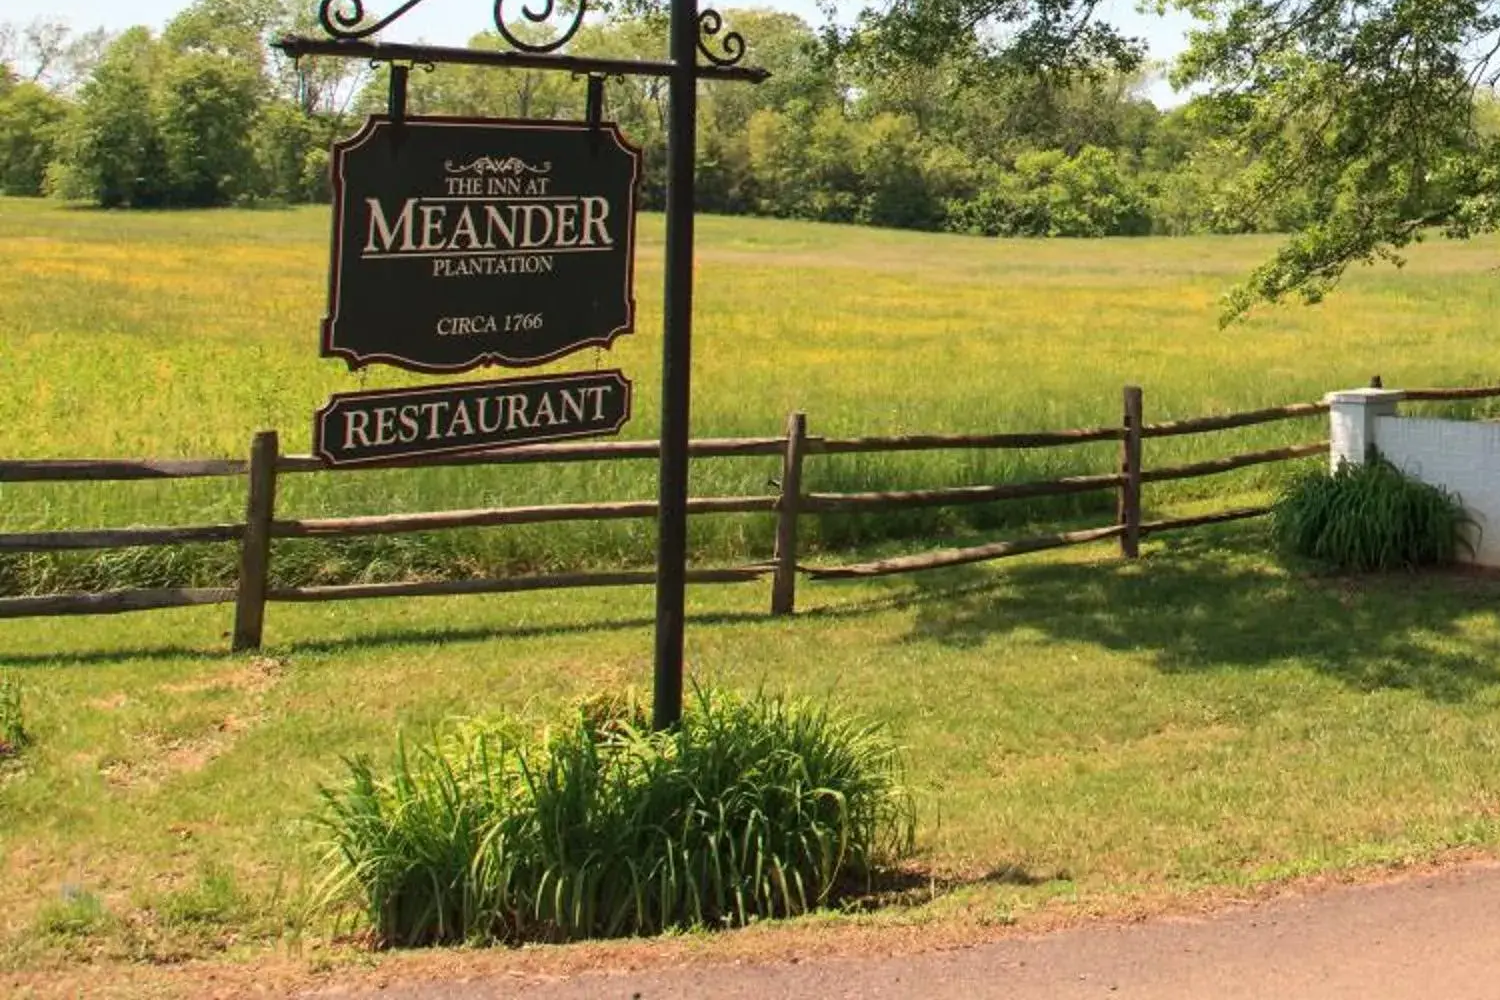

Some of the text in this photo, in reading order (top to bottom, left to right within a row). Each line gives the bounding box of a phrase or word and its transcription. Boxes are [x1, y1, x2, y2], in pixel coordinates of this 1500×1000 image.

[446, 177, 550, 196] THE INN AT
[363, 196, 614, 251] MEANDER
[432, 256, 553, 277] PLANTATION
[437, 313, 544, 336] CIRCA 1766
[342, 385, 613, 450] RESTAURANT
